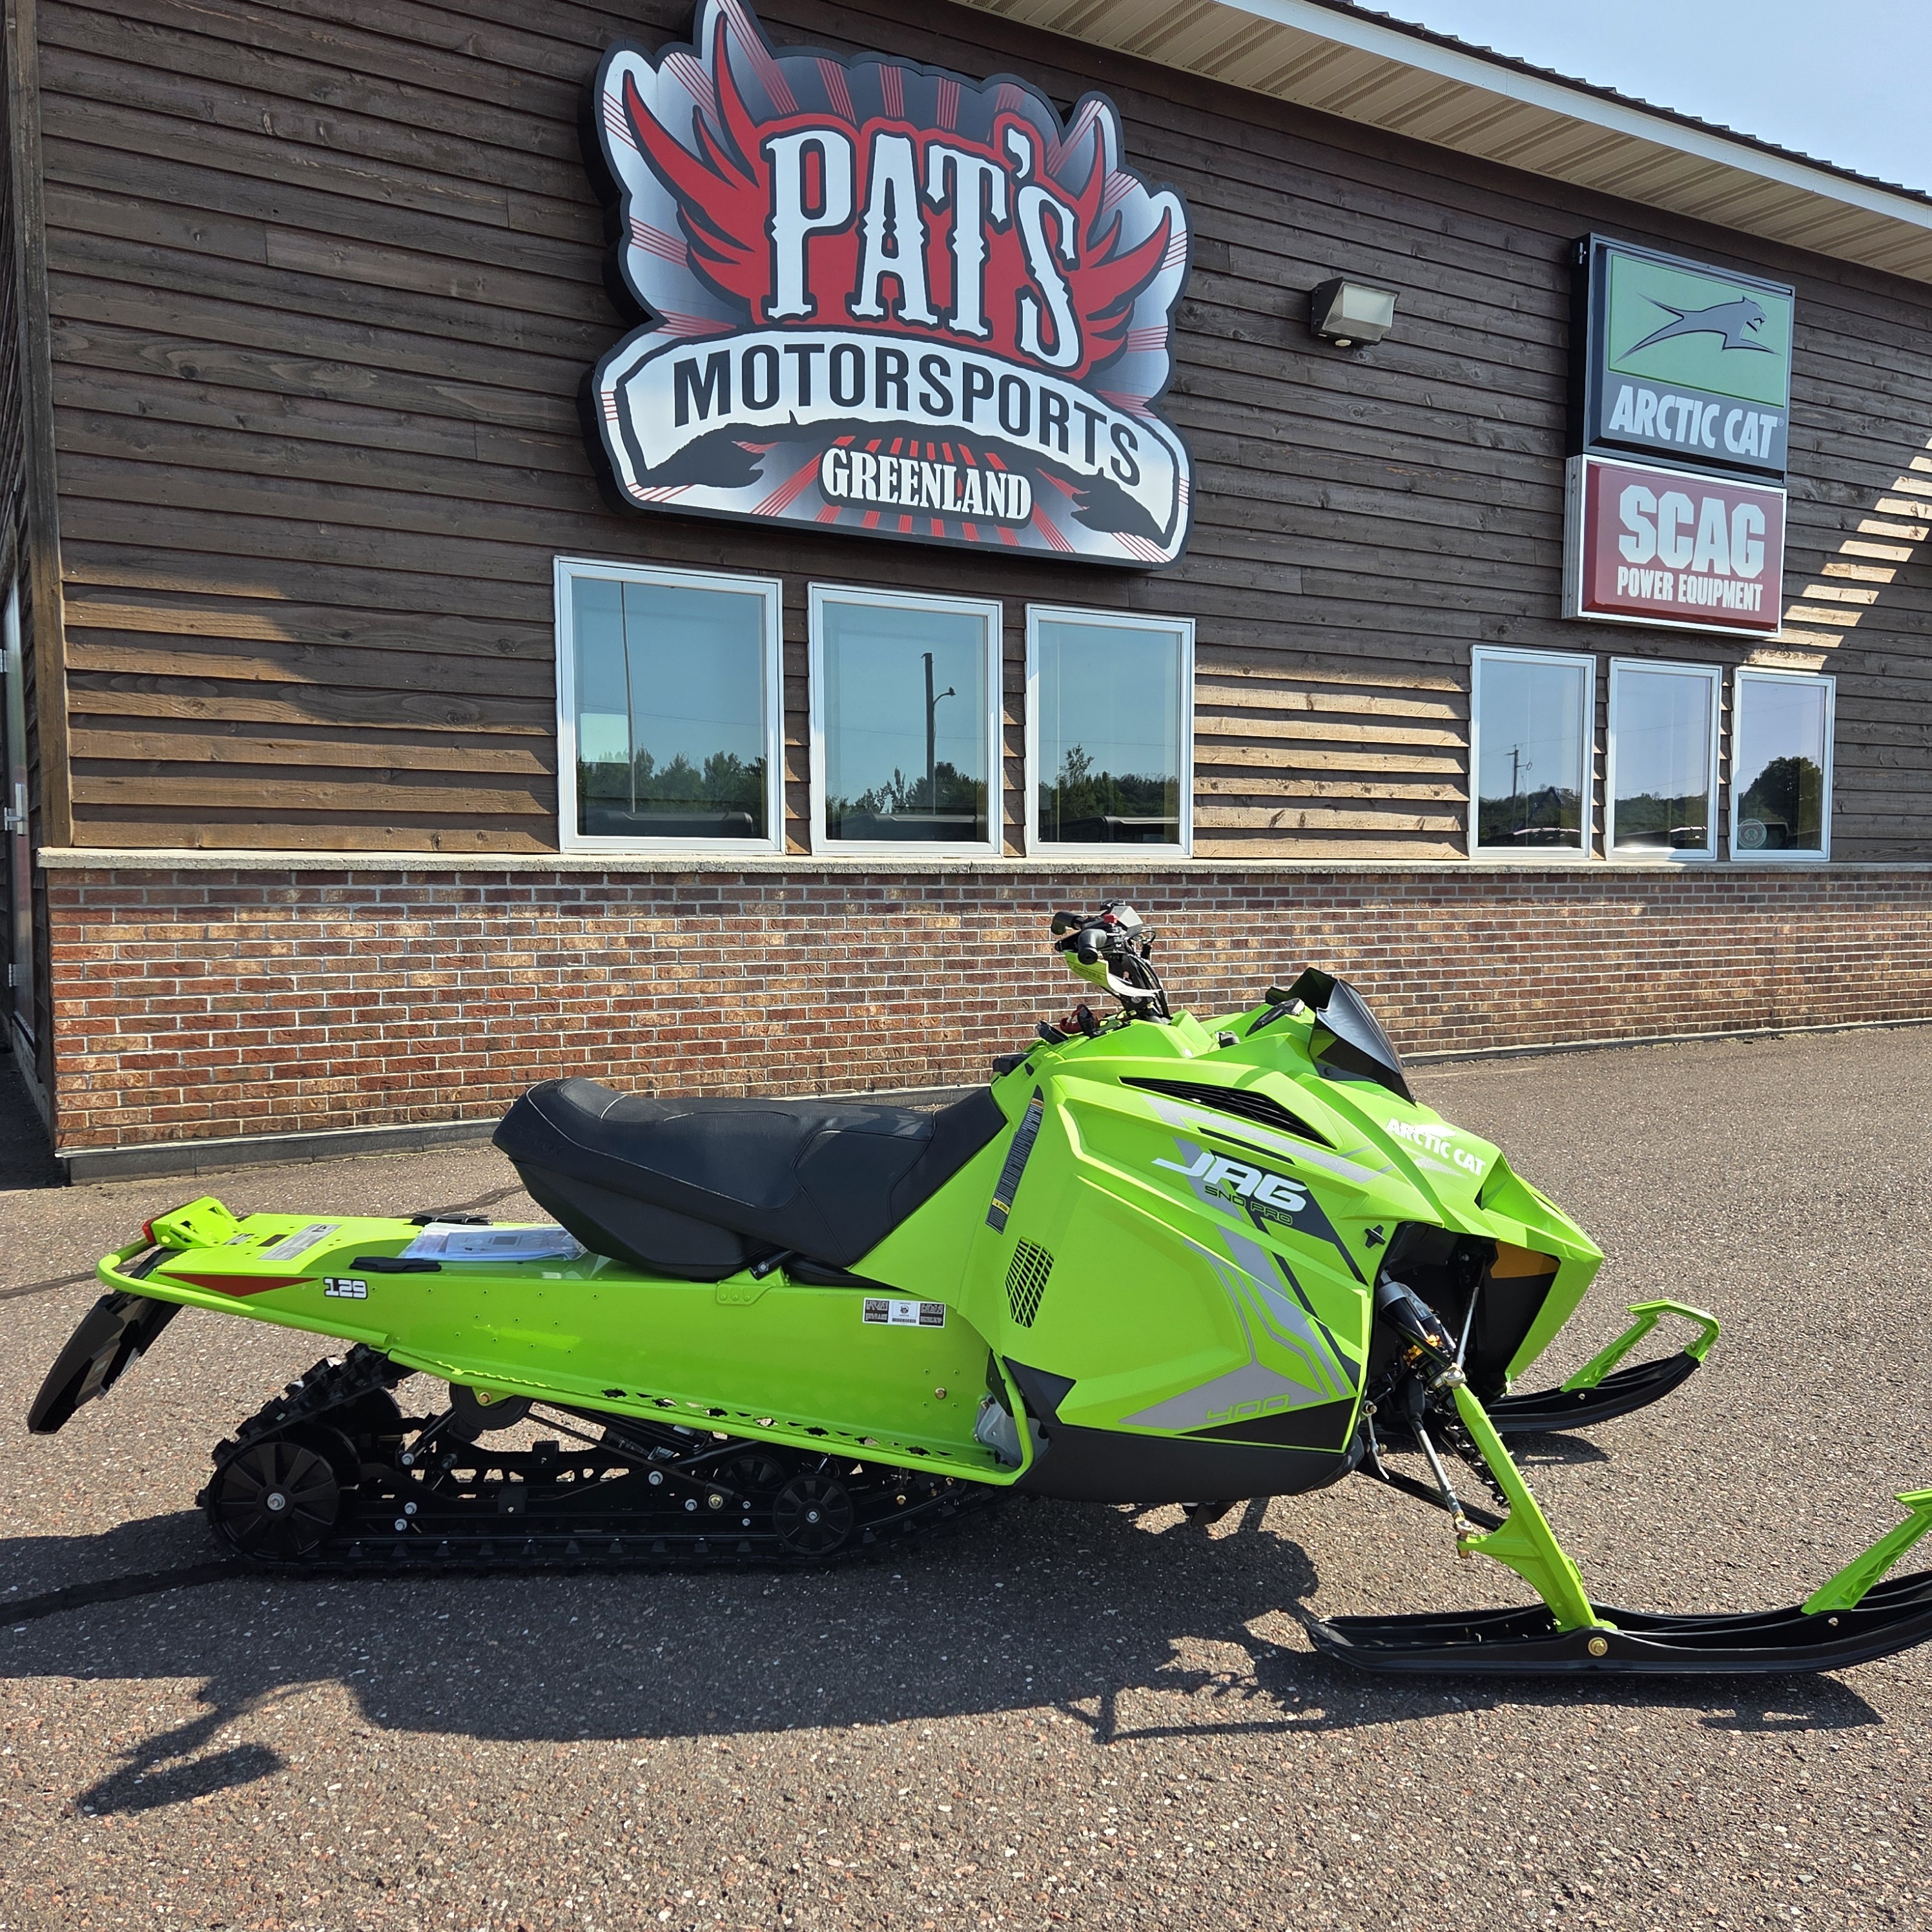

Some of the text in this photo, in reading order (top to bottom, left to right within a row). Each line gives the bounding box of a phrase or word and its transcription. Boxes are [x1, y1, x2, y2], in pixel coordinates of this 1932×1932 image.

[766, 128, 1082, 369] PAT'S
[673, 343, 1140, 488] MOTORSPORTS
[1608, 385, 1720, 449] ARCTIC
[822, 447, 1031, 519] GREENLAND
[1619, 484, 1765, 579] SCAG
[1618, 566, 1763, 611] POWER EQUIPMENT
[1386, 1118, 1486, 1176] ARCTIC CAT
[1151, 1152, 1308, 1211] JAG
[1205, 1186, 1292, 1225] SNO PRO
[324, 1279, 367, 1299] 129
[1206, 1394, 1290, 1419] 400
